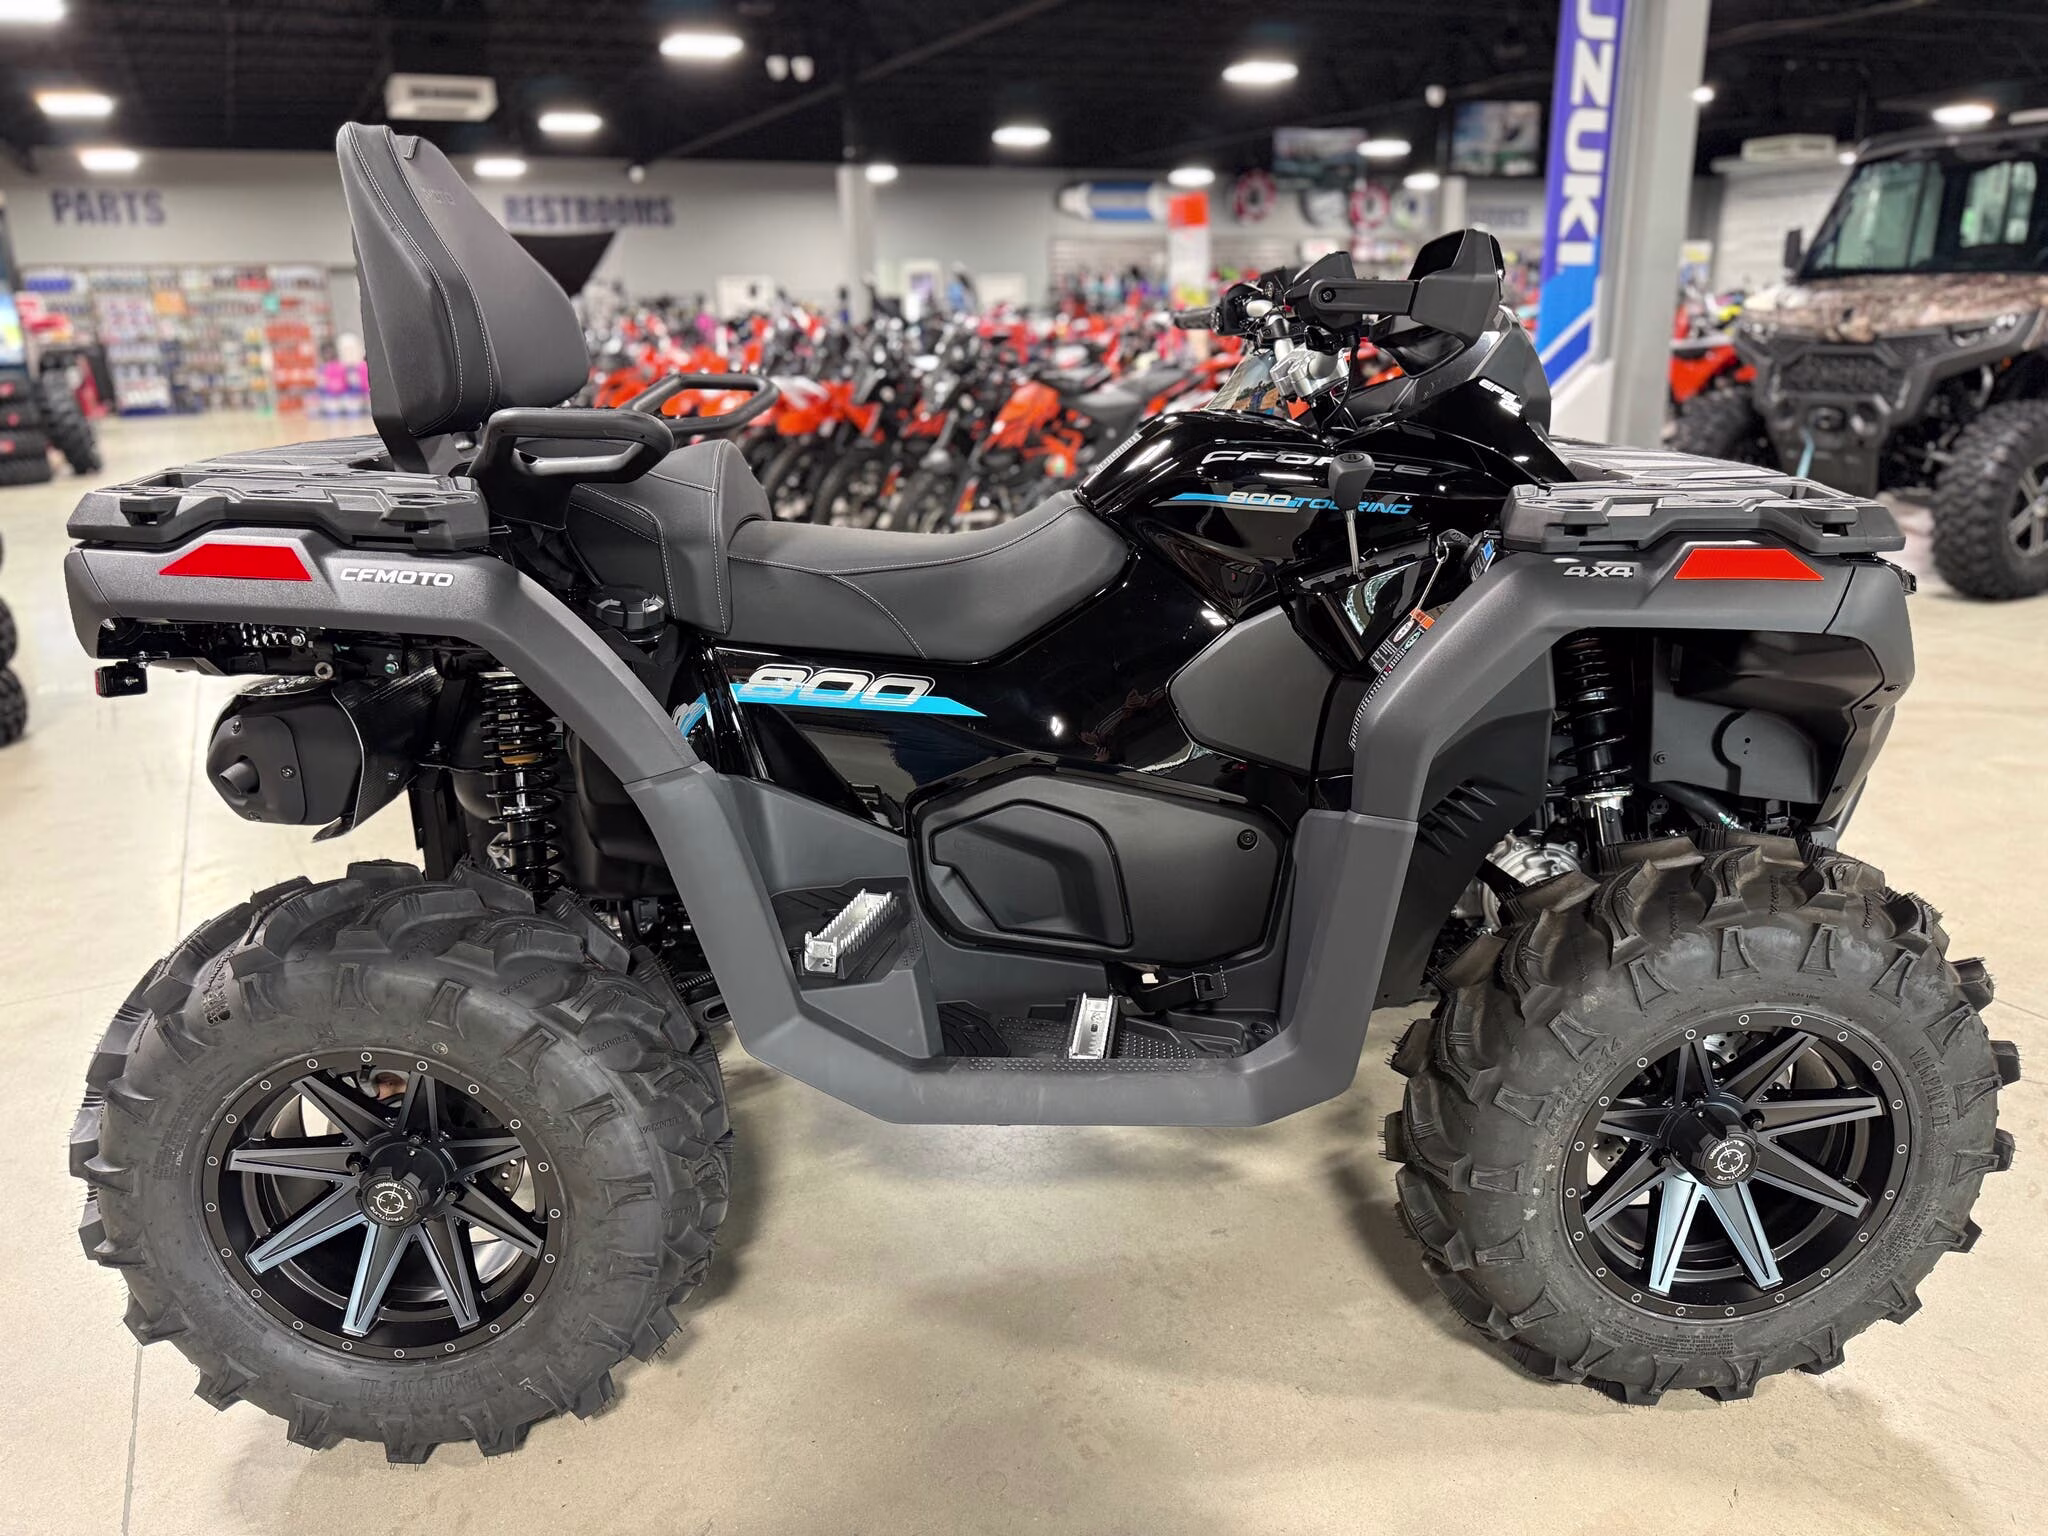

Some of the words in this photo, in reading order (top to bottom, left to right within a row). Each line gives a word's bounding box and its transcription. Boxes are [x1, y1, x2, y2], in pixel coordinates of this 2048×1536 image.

[51, 187, 166, 226] PARTS
[505, 195, 675, 226] RESTROOMS
[1201, 450, 1432, 477] CFOE
[340, 567, 454, 587] CFMOTO
[737, 663, 936, 706] 800
